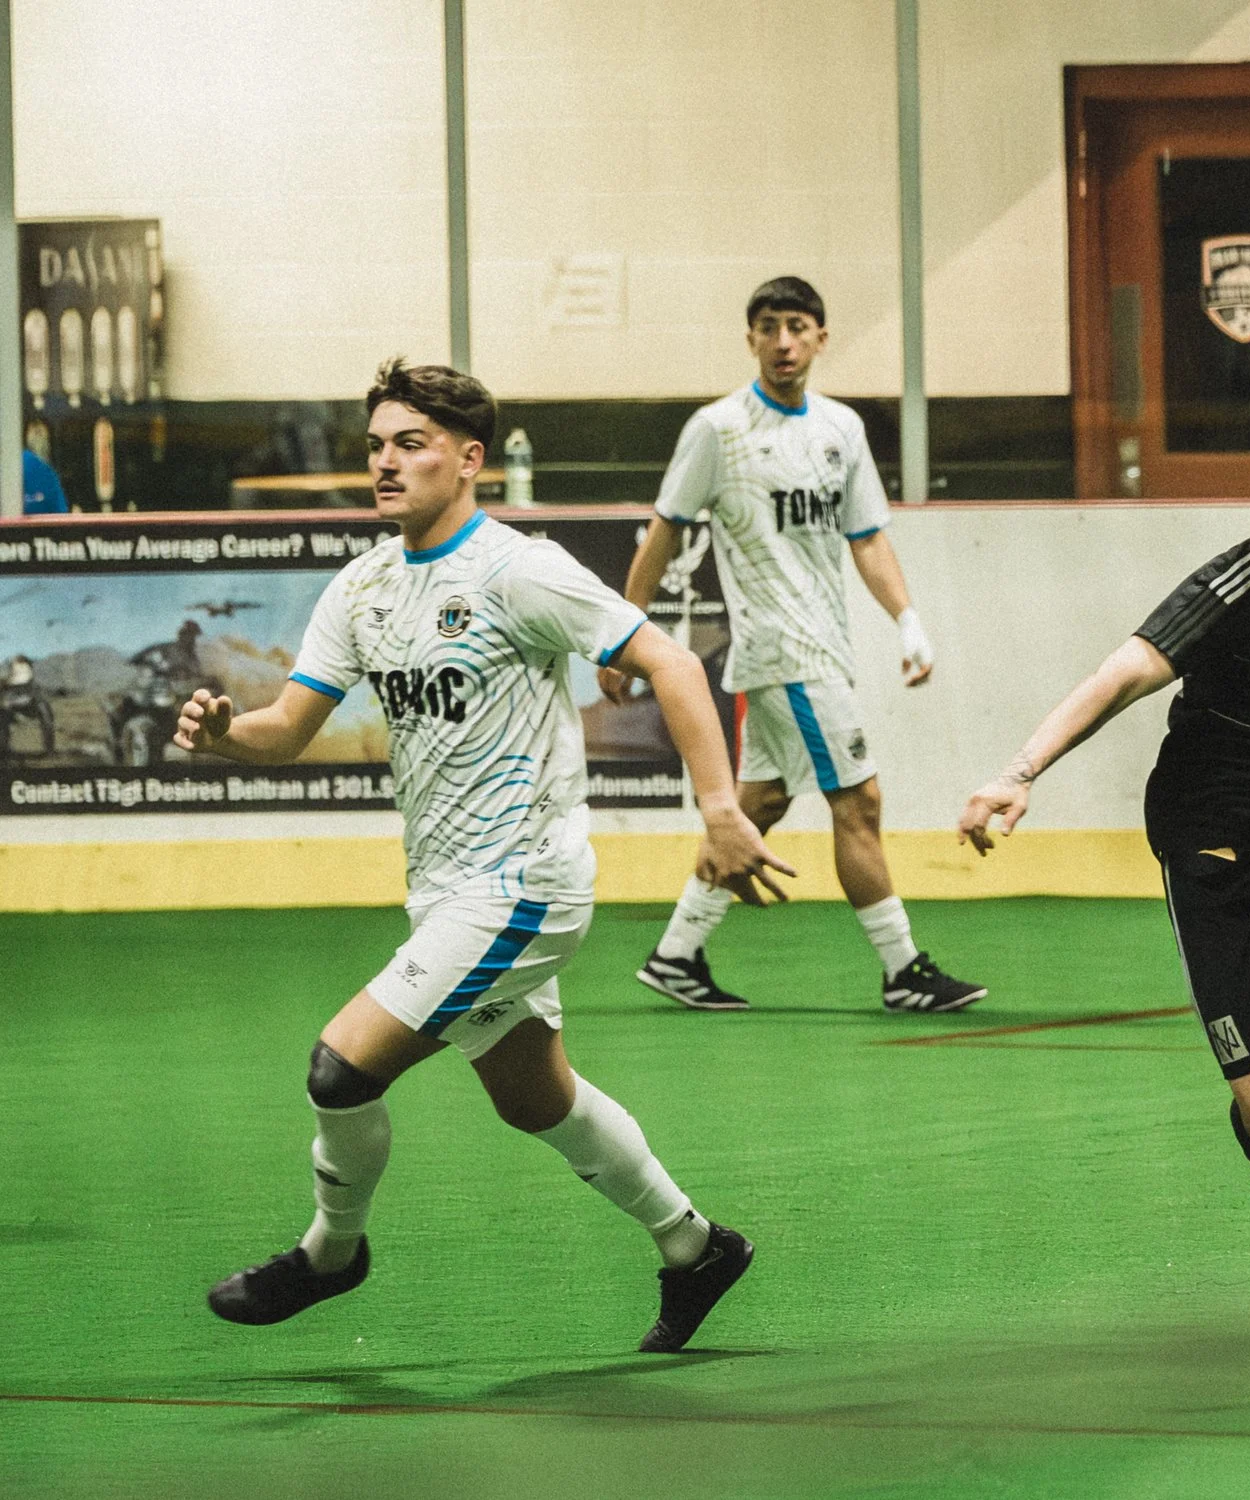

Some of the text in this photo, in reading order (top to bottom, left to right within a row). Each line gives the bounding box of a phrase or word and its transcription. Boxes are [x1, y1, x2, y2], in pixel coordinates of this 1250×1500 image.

[34, 537, 87, 561] Than
[86, 536, 134, 560] Your
[135, 535, 219, 563] Average
[221, 534, 304, 558] Career?
[11, 780, 95, 804] Contact
[96, 778, 144, 807] TSgt
[145, 777, 225, 802] Desiree
[227, 776, 305, 800] Beltran
[307, 776, 331, 799] at
